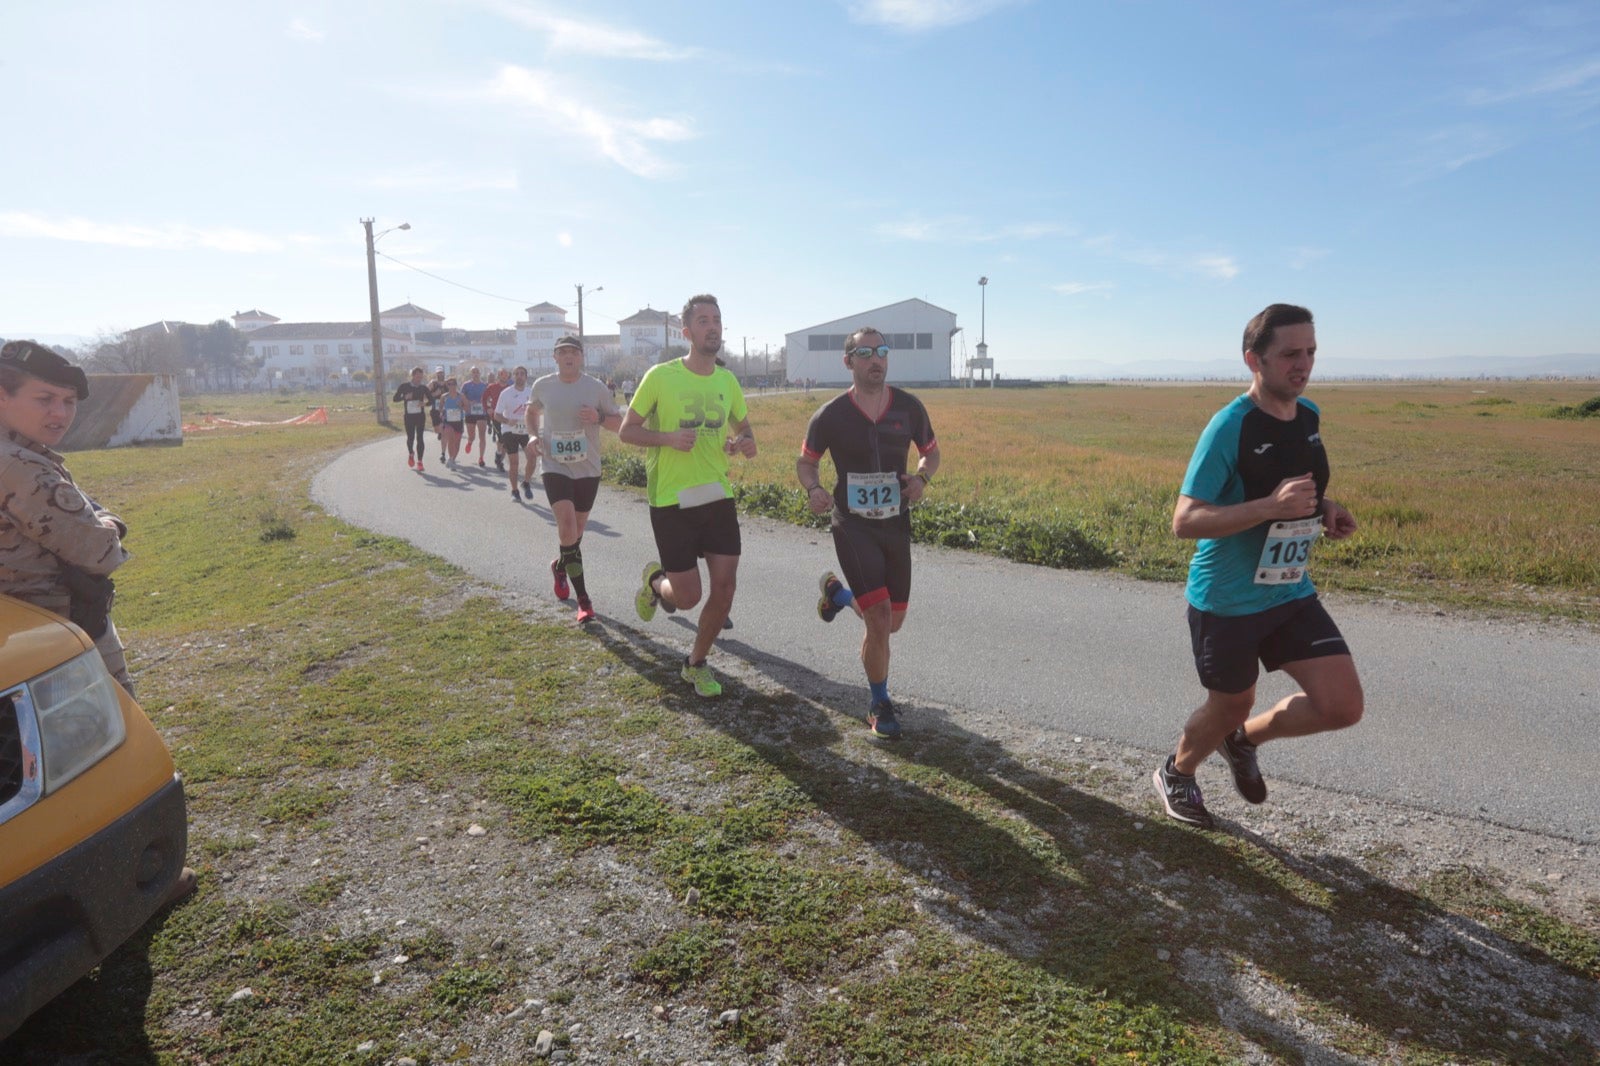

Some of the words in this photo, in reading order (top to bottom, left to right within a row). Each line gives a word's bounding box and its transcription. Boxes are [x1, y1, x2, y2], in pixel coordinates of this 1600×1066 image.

[556, 441, 581, 453] 948
[857, 486, 892, 505] 312
[1269, 540, 1310, 565] 103
